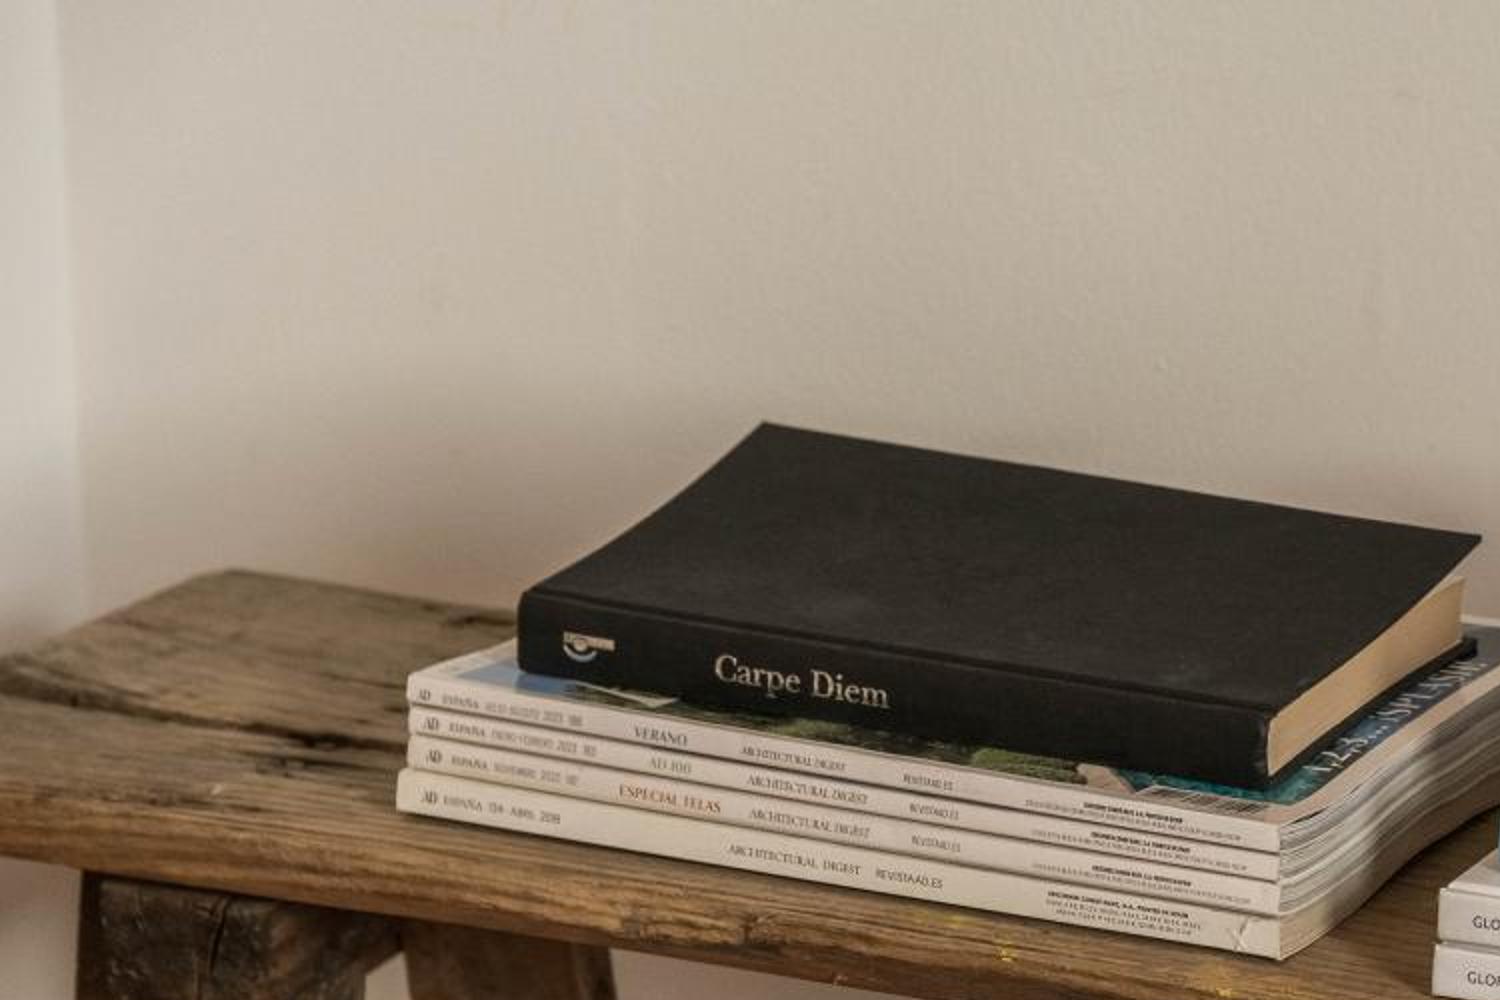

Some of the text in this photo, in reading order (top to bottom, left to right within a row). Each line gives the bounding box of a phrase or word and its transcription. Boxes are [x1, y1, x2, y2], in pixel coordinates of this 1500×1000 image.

[715, 654, 890, 708] Carpe Diem
[634, 726, 688, 747] VERANO
[618, 784, 721, 813] ESPECIAL TELAS
[822, 859, 861, 876] DIGEST
